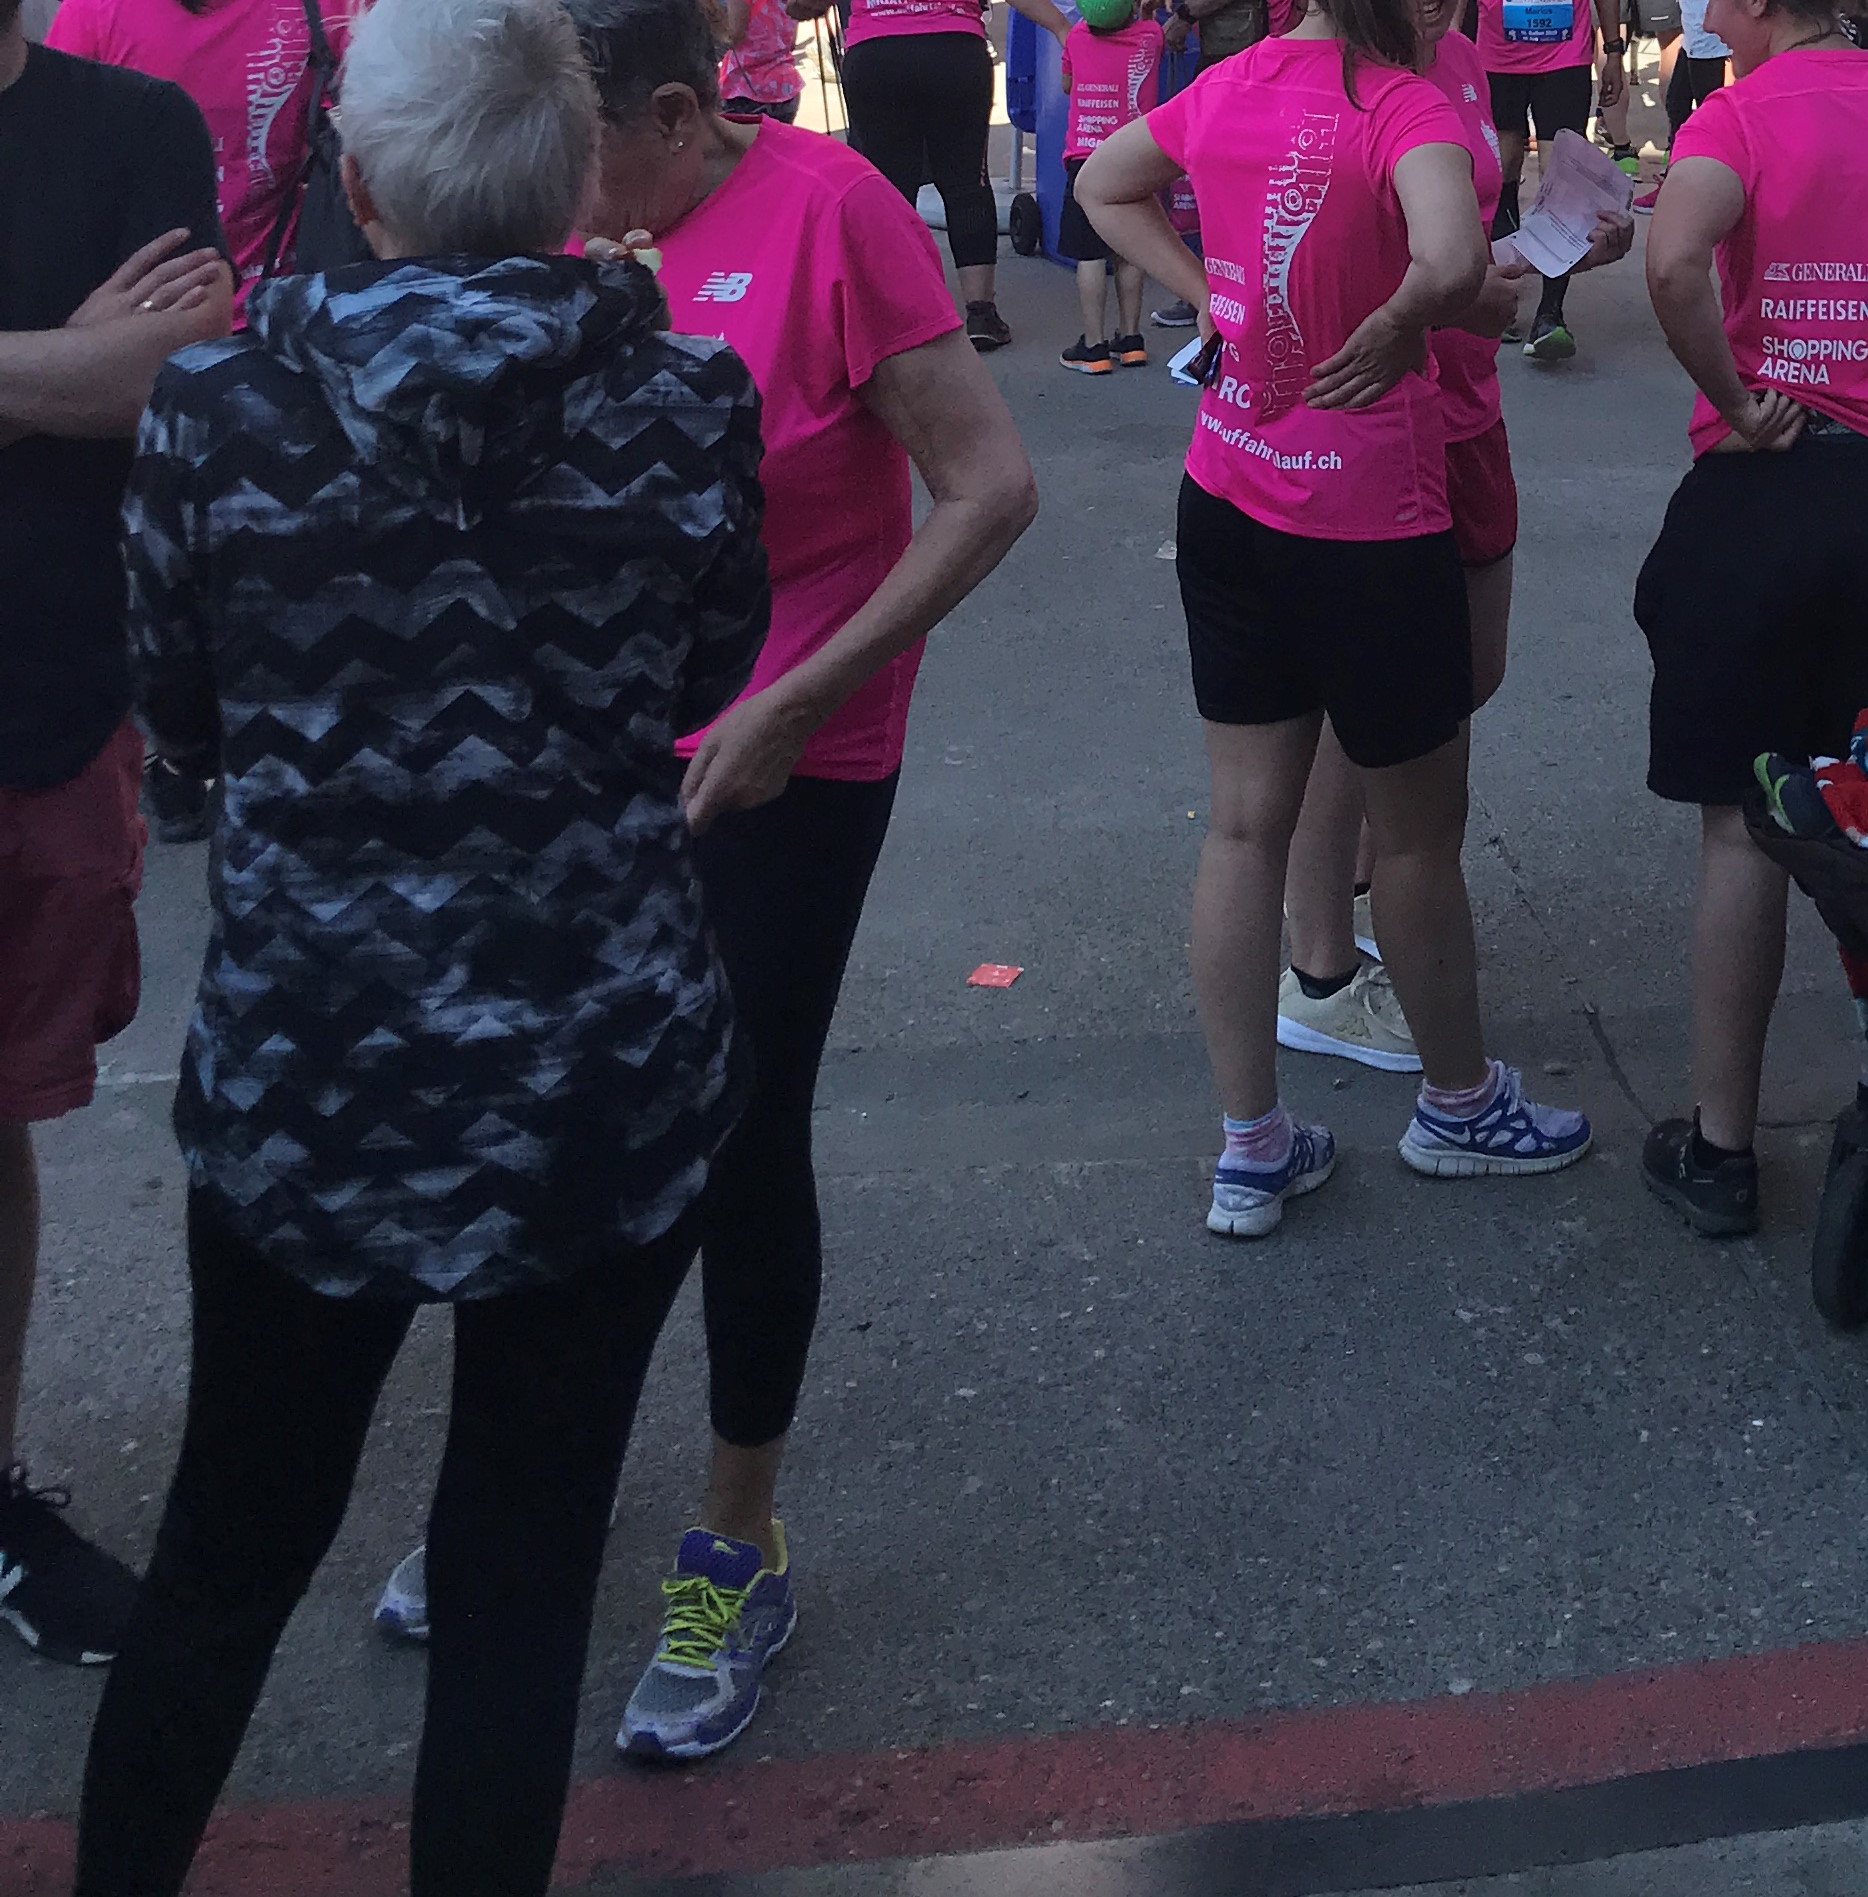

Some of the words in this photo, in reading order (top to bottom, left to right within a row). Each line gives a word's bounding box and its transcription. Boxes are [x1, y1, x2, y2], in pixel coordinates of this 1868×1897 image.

[1526, 17, 1552, 29] 1592
[1762, 335, 1868, 361] SHOPPING
[1757, 356, 1831, 385] ARENA
